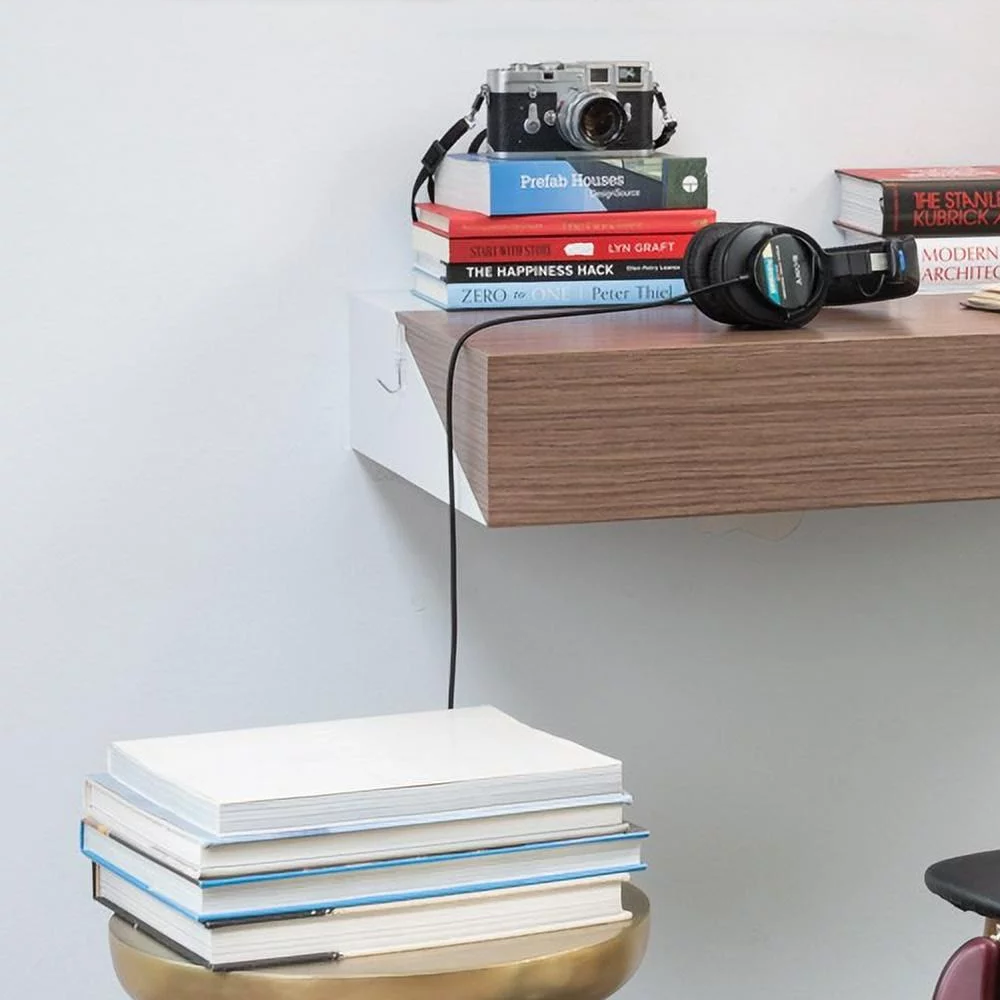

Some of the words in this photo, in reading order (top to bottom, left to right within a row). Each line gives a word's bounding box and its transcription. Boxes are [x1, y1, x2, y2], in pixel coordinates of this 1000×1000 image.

[520, 173, 568, 189] Prefab
[572, 172, 625, 188] Houses
[913, 191, 940, 208] THE
[913, 209, 989, 227] KUBRICK
[608, 243, 631, 254] LYN
[634, 241, 675, 253] GRAFT
[921, 245, 999, 262] MODERN
[465, 266, 492, 278] THE
[497, 265, 573, 277] HAPPINESS
[577, 264, 614, 276] HACK
[461, 288, 507, 303] ZERO
[513, 289, 527, 300] to
[592, 286, 630, 301] Peter
[634, 284, 673, 300] Thiel
